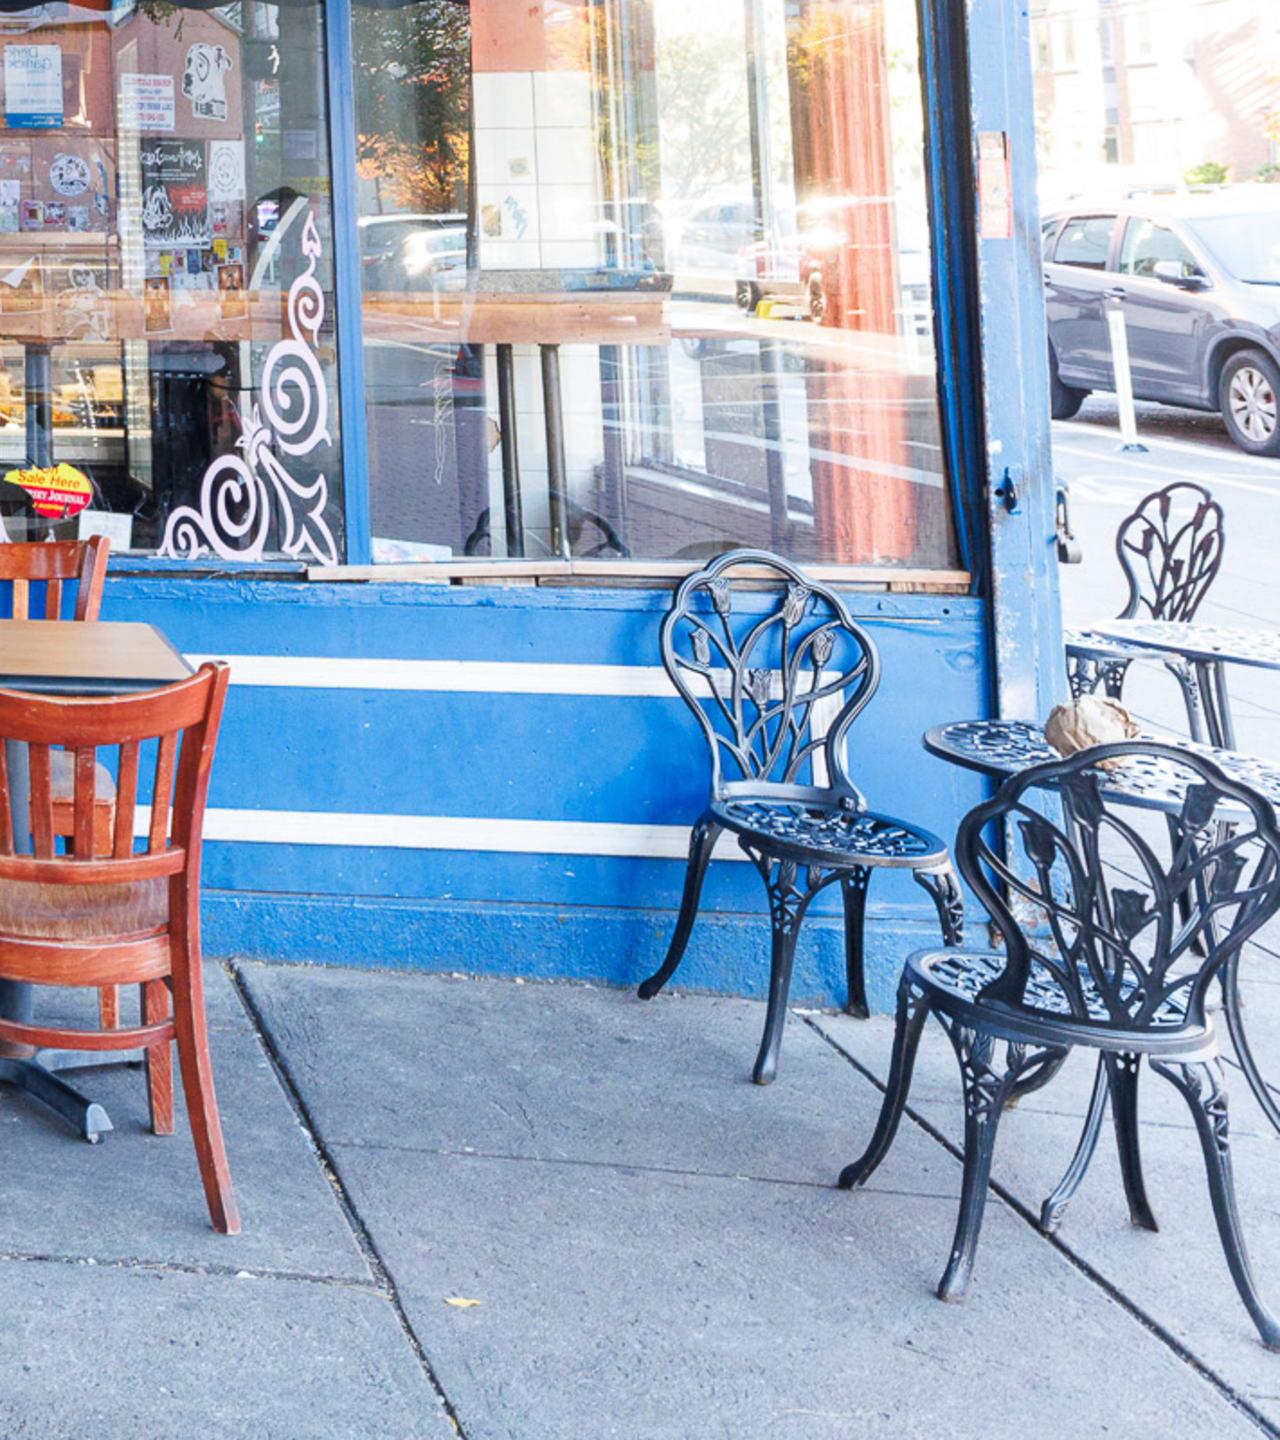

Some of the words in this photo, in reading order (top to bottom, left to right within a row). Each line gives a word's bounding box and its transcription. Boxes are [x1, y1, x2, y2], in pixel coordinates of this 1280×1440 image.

[18, 470, 46, 485] Sale
[50, 475, 81, 489] Here
[48, 491, 86, 505] JOURNAL
